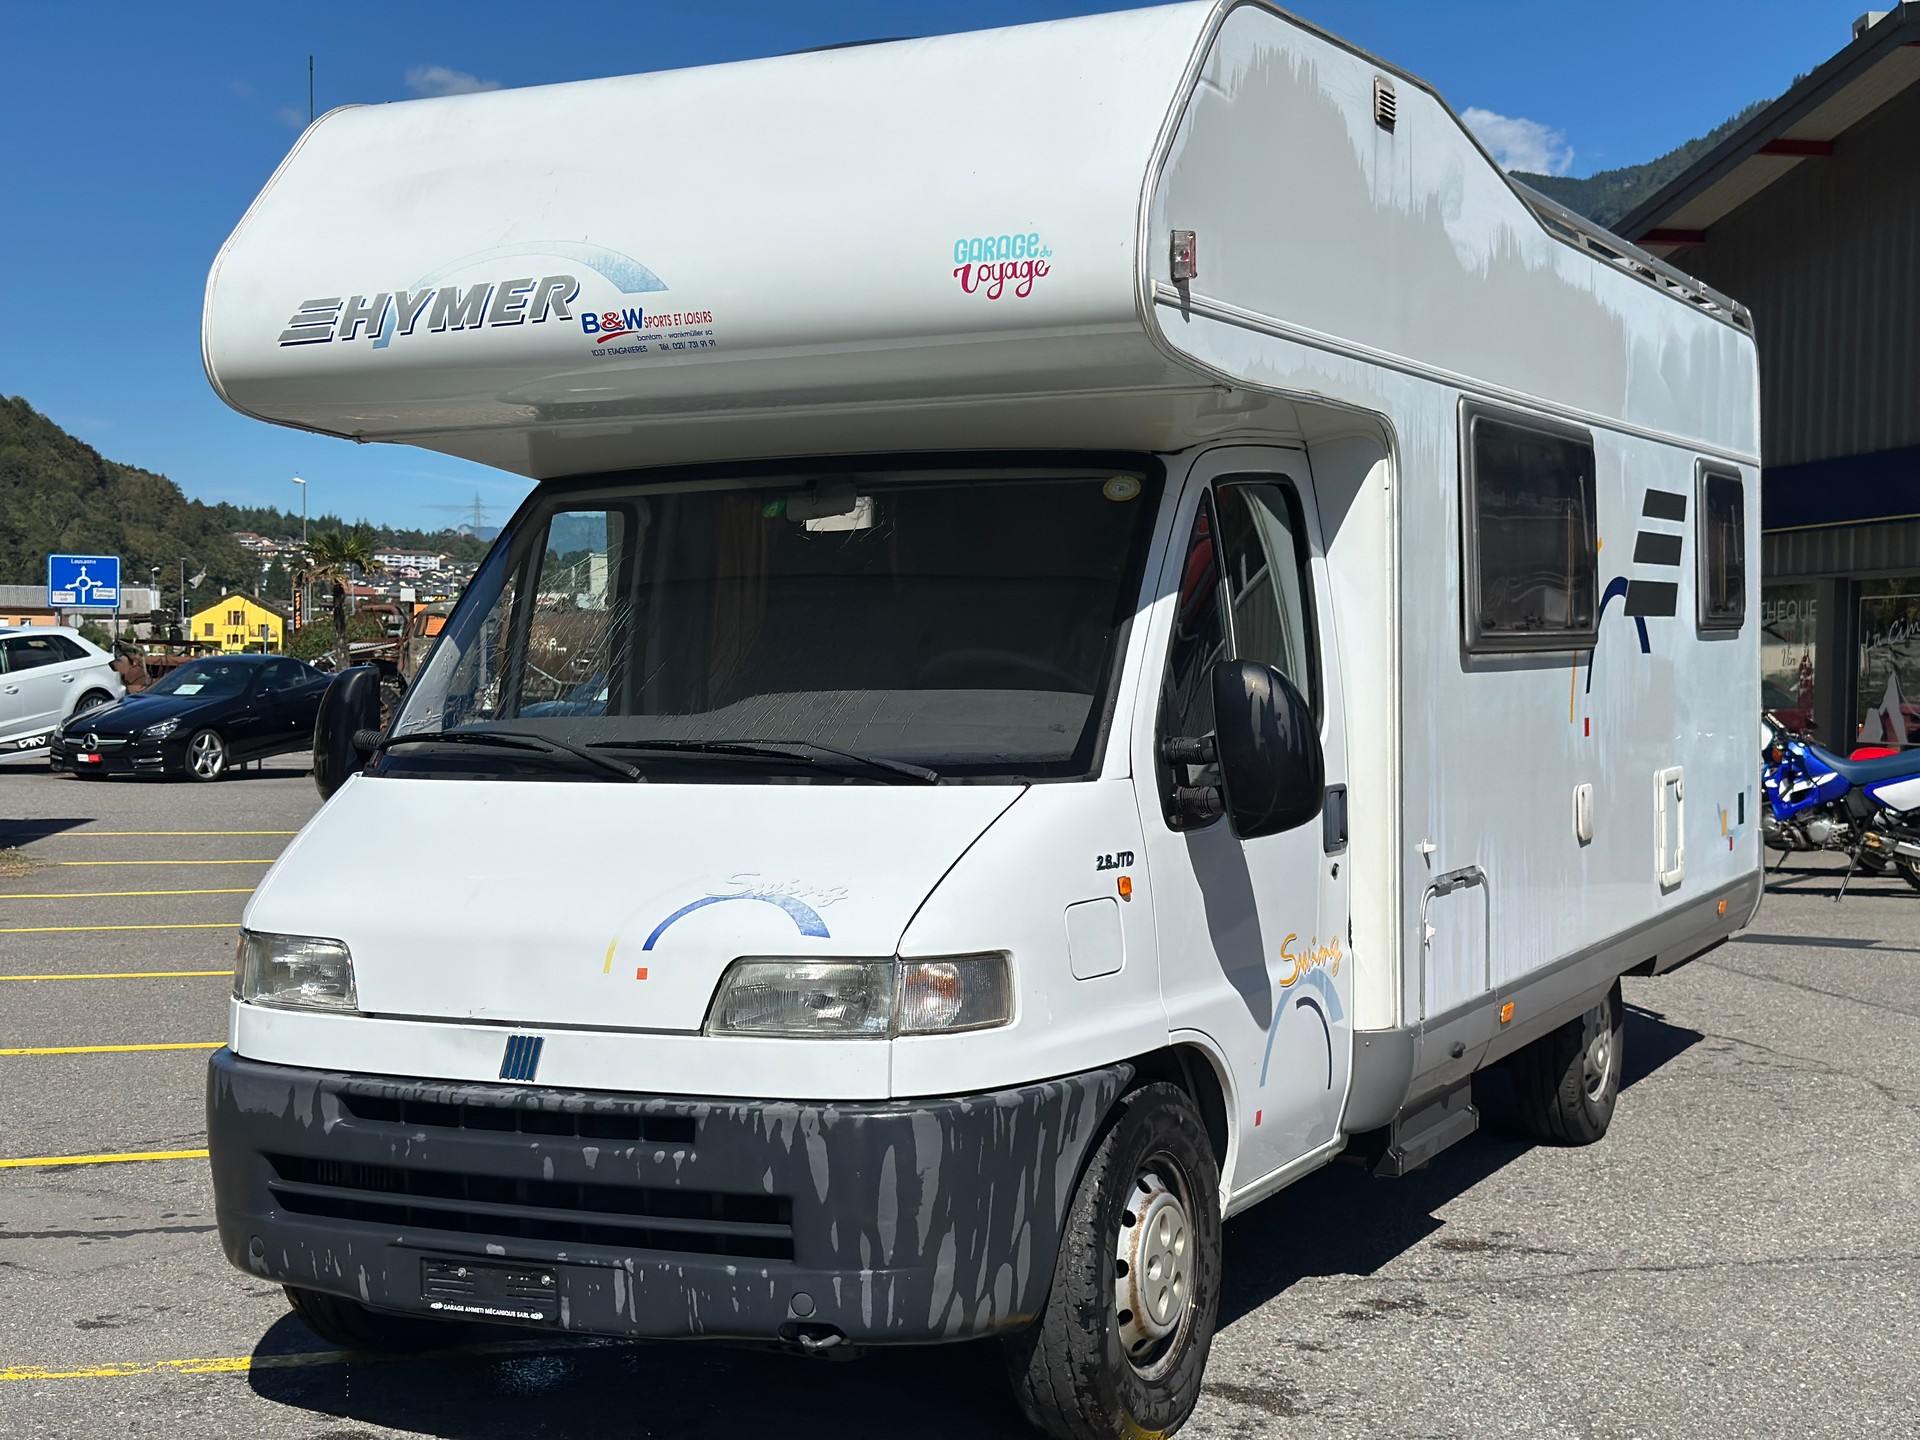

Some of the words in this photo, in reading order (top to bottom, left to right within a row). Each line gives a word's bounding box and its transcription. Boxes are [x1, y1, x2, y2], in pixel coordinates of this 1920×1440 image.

[1040, 245, 1053, 258] du
[338, 274, 580, 342] HYMER
[581, 307, 643, 334] B&W
[644, 314, 673, 329] SPORTS
[674, 313, 682, 326] ET
[684, 311, 713, 325] LOISIRS
[1279, 932, 1343, 987] Swing
[443, 1303, 465, 1312] GARAGE
